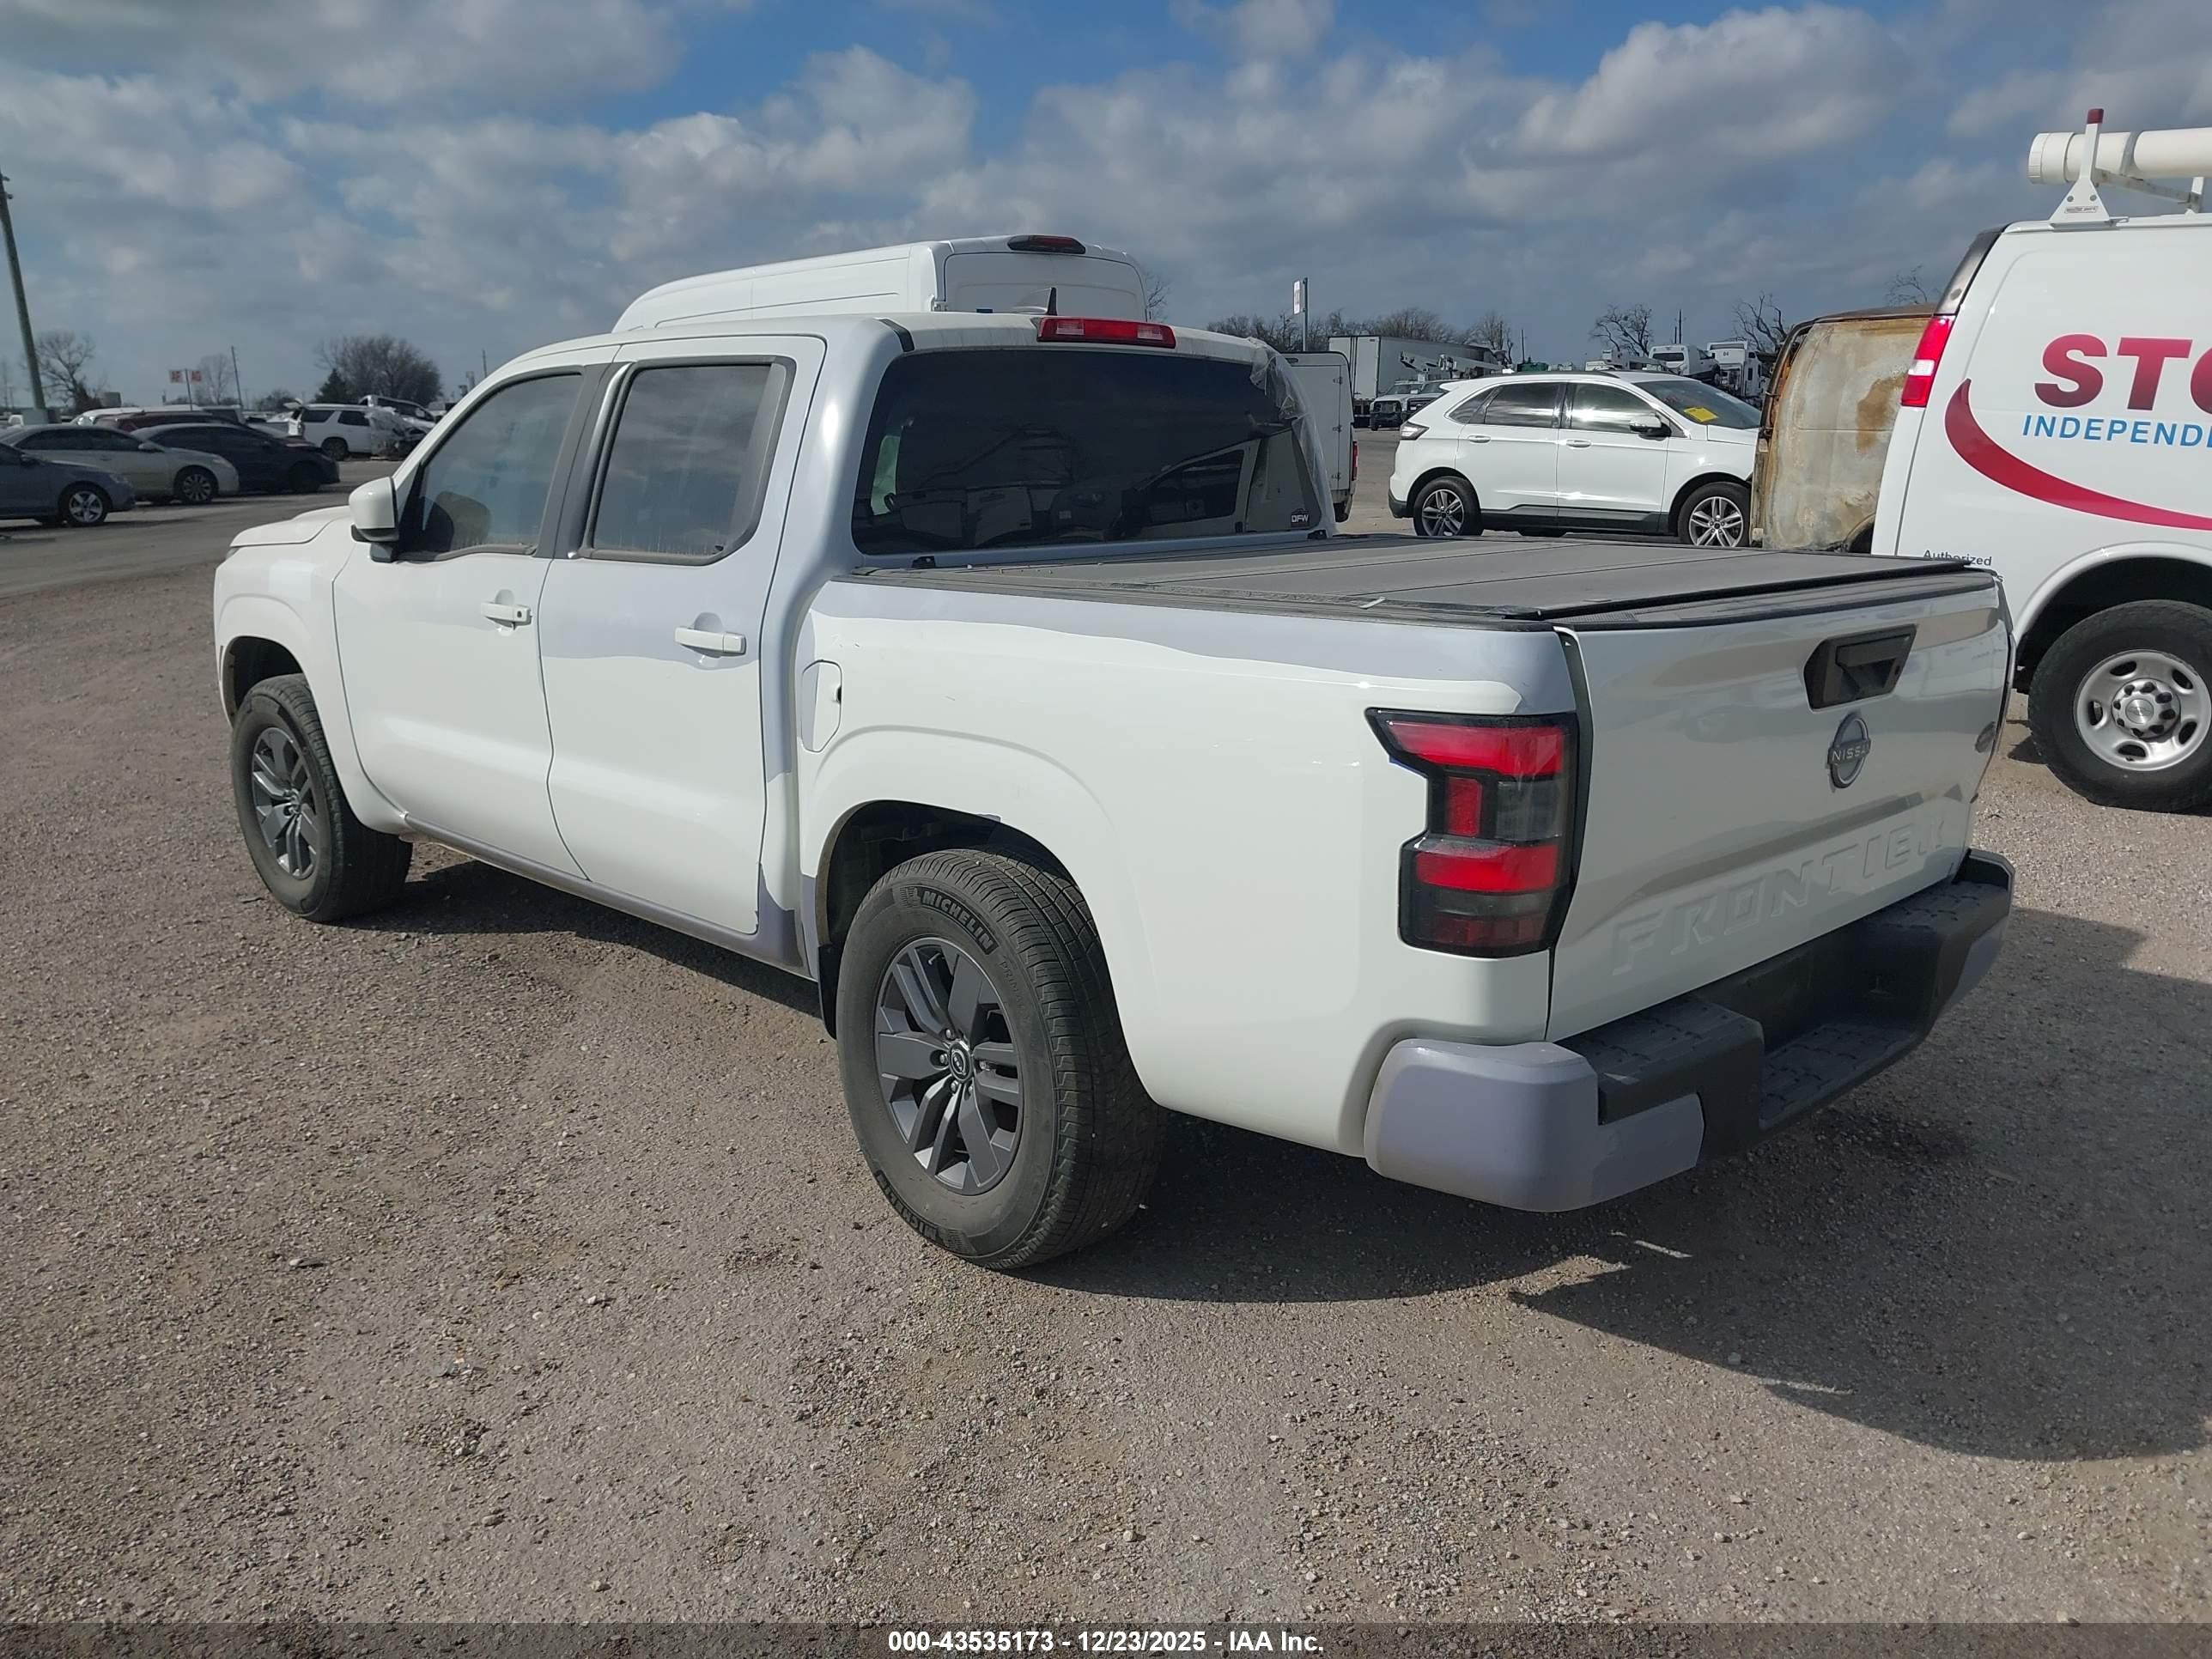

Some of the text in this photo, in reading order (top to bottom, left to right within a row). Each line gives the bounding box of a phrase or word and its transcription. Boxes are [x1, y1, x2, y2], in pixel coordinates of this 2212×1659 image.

[2033, 332, 2212, 414] ST
[1291, 514, 1310, 523] DFW
[921, 890, 994, 950] MICHELIN
